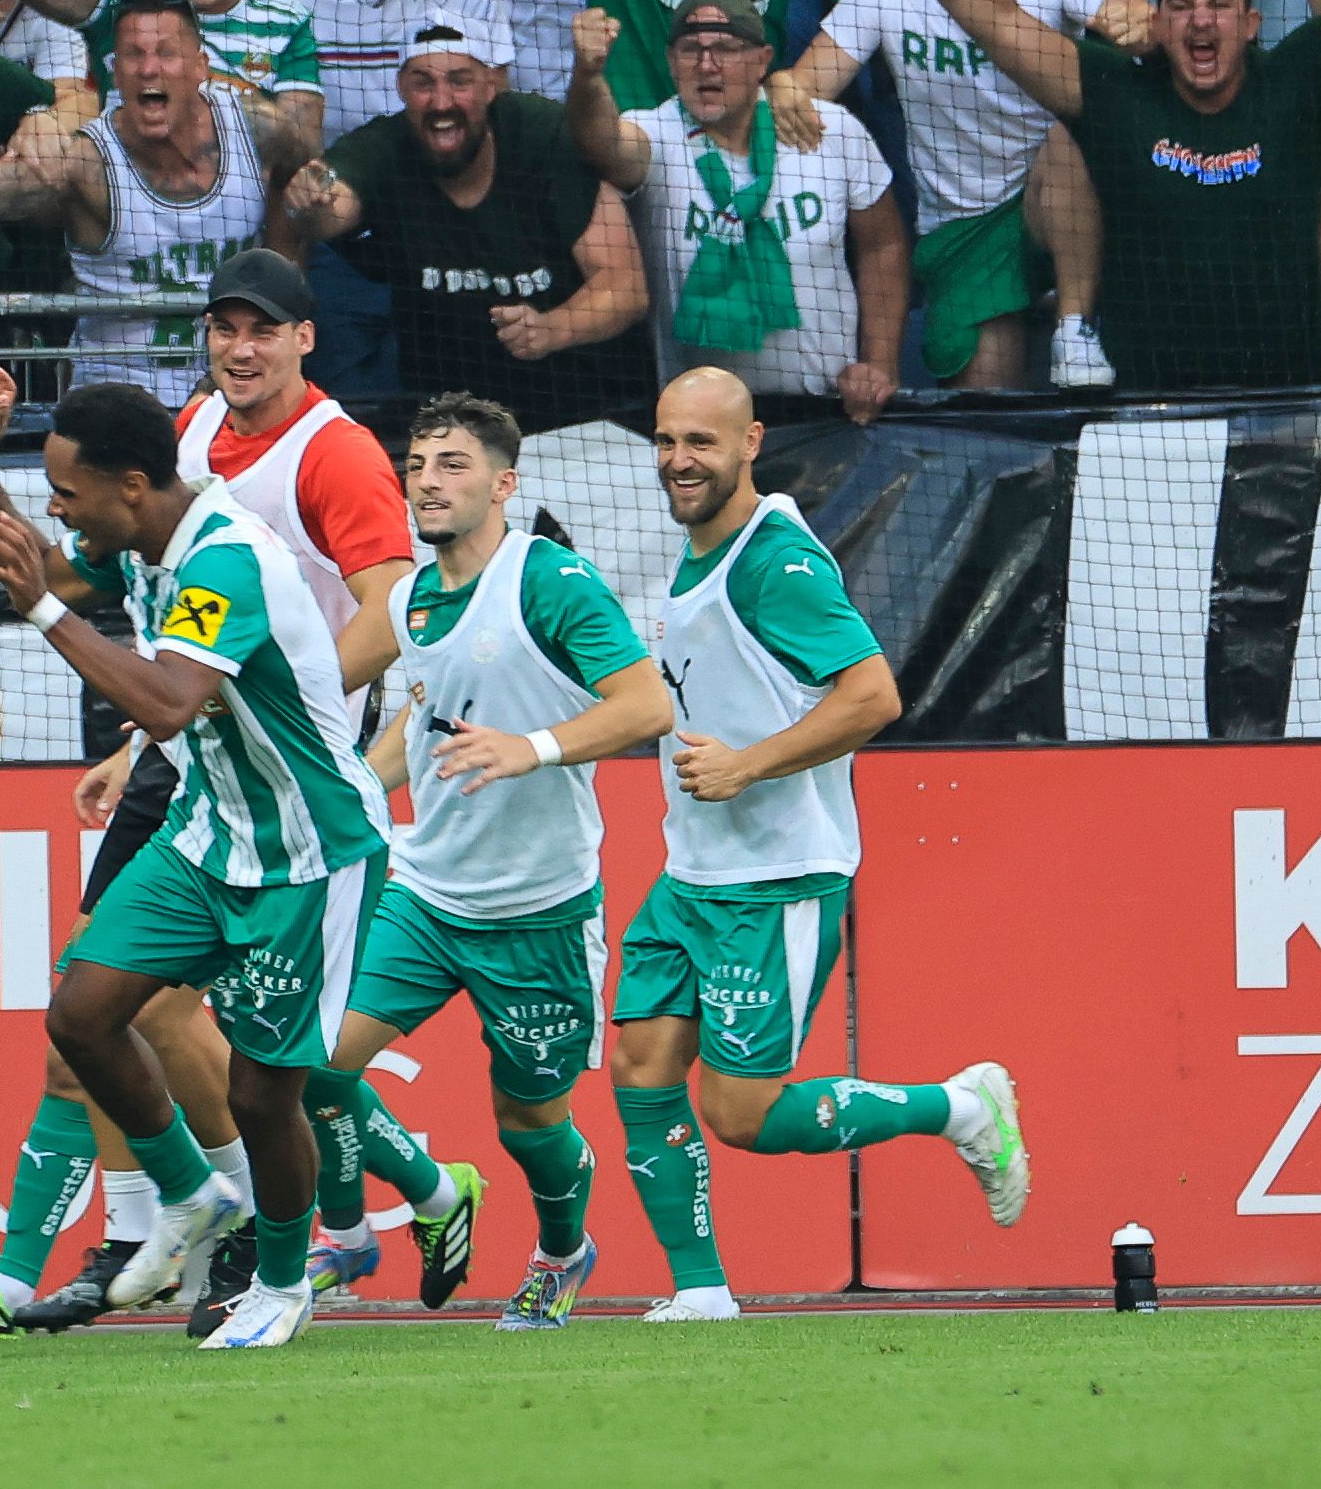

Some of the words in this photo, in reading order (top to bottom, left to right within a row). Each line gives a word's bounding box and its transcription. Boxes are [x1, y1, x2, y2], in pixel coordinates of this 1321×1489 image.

[902, 28, 989, 77] RAP
[683, 192, 823, 241] RID
[39, 1156, 94, 1237] easystaff
[683, 1140, 711, 1239] easystaff
